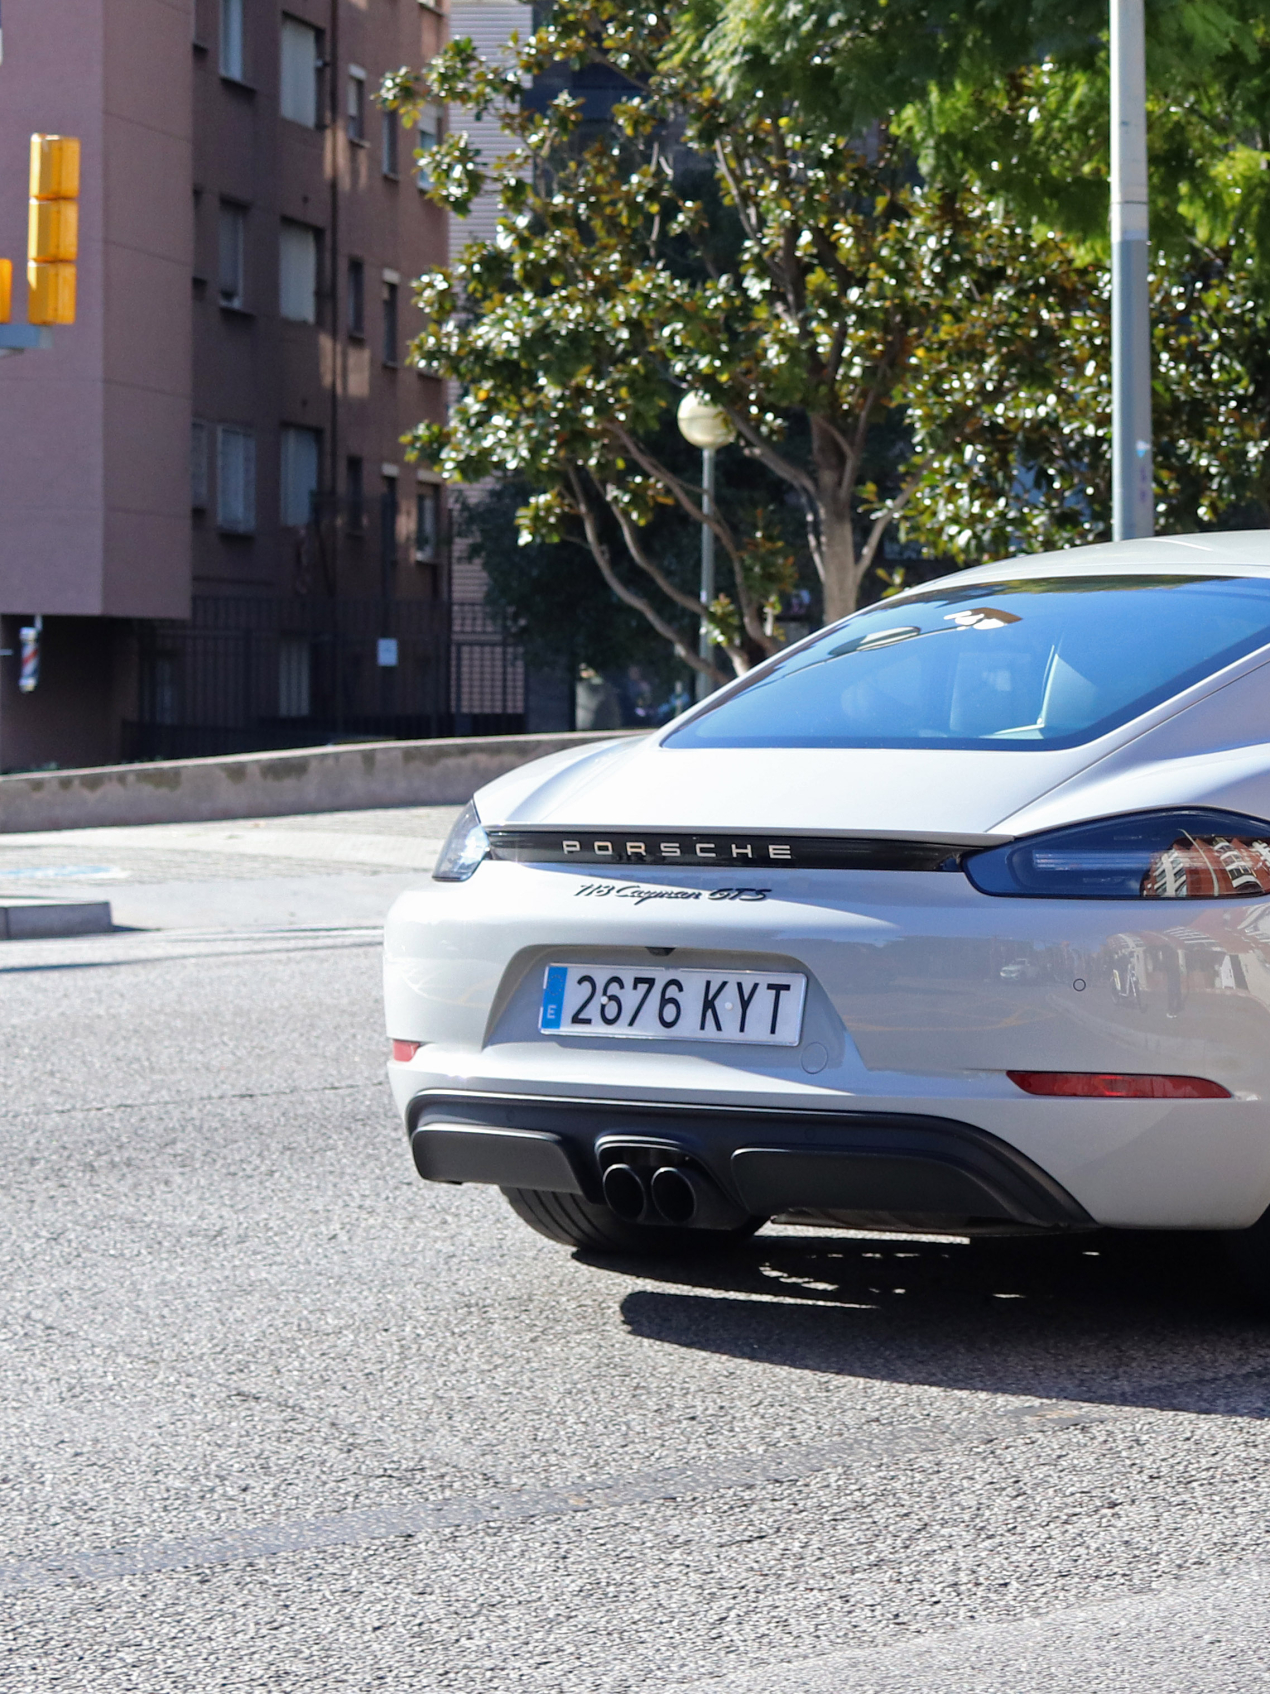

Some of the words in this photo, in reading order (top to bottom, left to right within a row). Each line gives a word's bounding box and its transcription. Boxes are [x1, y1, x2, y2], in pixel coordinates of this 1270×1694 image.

[562, 840, 792, 859] PORSCHE
[616, 885, 702, 906] Cayman
[708, 887, 772, 901] GTS
[546, 1004, 556, 1019] E
[571, 974, 684, 1029] 2676
[699, 979, 791, 1035] KYT
